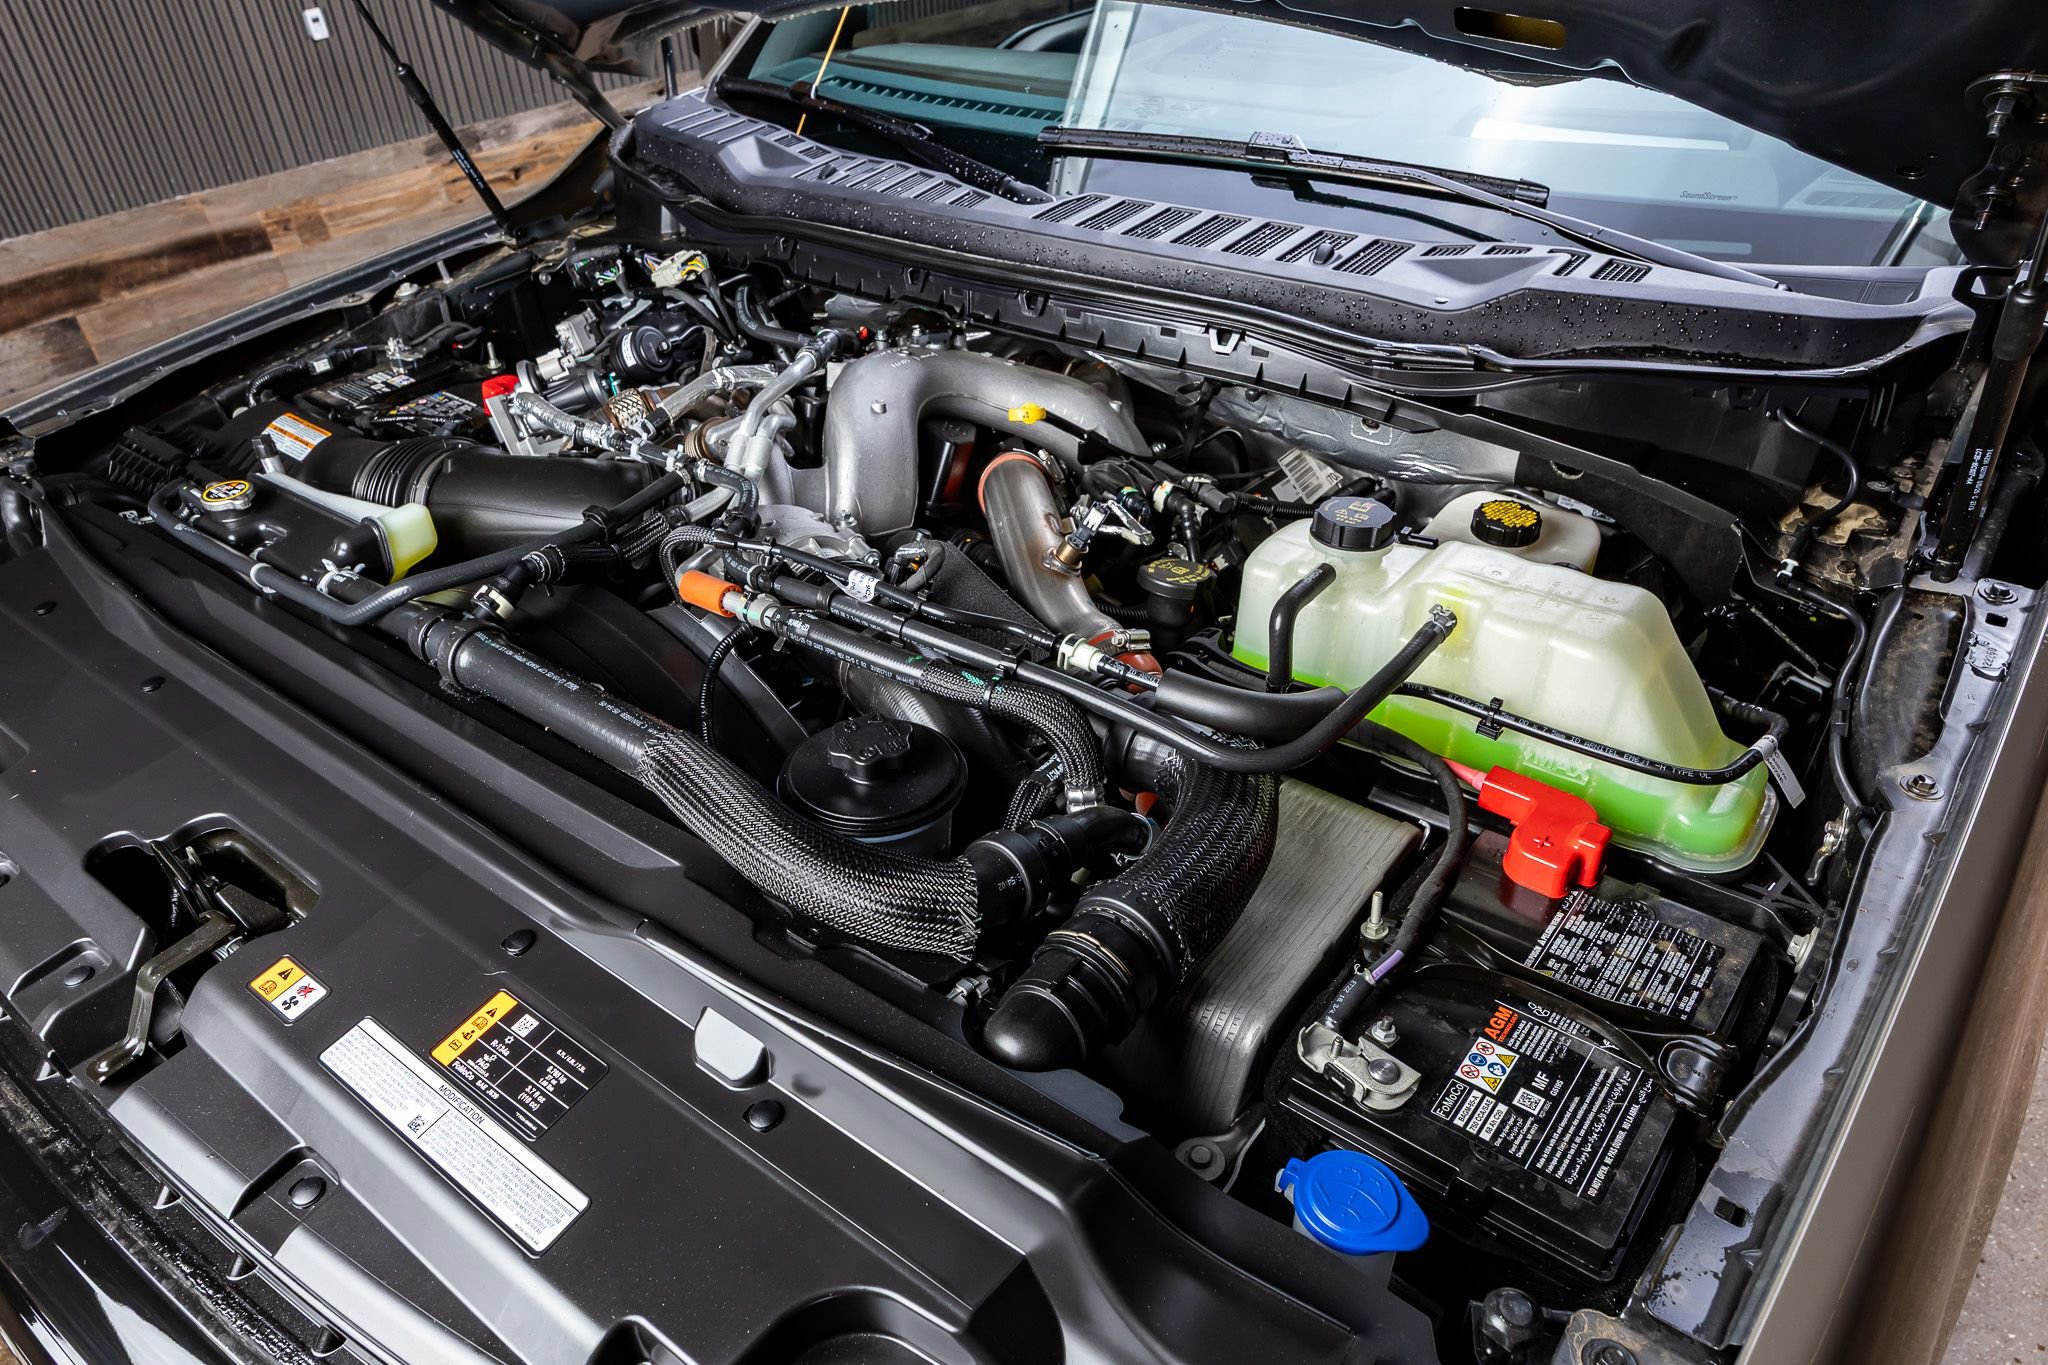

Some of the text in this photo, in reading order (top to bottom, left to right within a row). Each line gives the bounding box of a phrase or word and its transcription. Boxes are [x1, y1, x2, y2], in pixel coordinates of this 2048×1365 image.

[1679, 190, 1732, 200] SoundScreen
[1484, 1006, 1512, 1039] AGM
[1497, 1012, 1518, 1042] TECHNOLOGY
[489, 1039, 510, 1056] R-134a
[451, 1060, 475, 1080] FoMoCo
[475, 1079, 488, 1090] SAE
[1531, 1070, 1549, 1090] MF
[438, 1084, 485, 1124] MODIFICATION
[1435, 1081, 1465, 1117] FoMoCo
[1474, 1098, 1493, 1121] CCA/SAE
[1590, 1176, 1602, 1189] NOT
[1595, 1164, 1609, 1179] OPEN.
